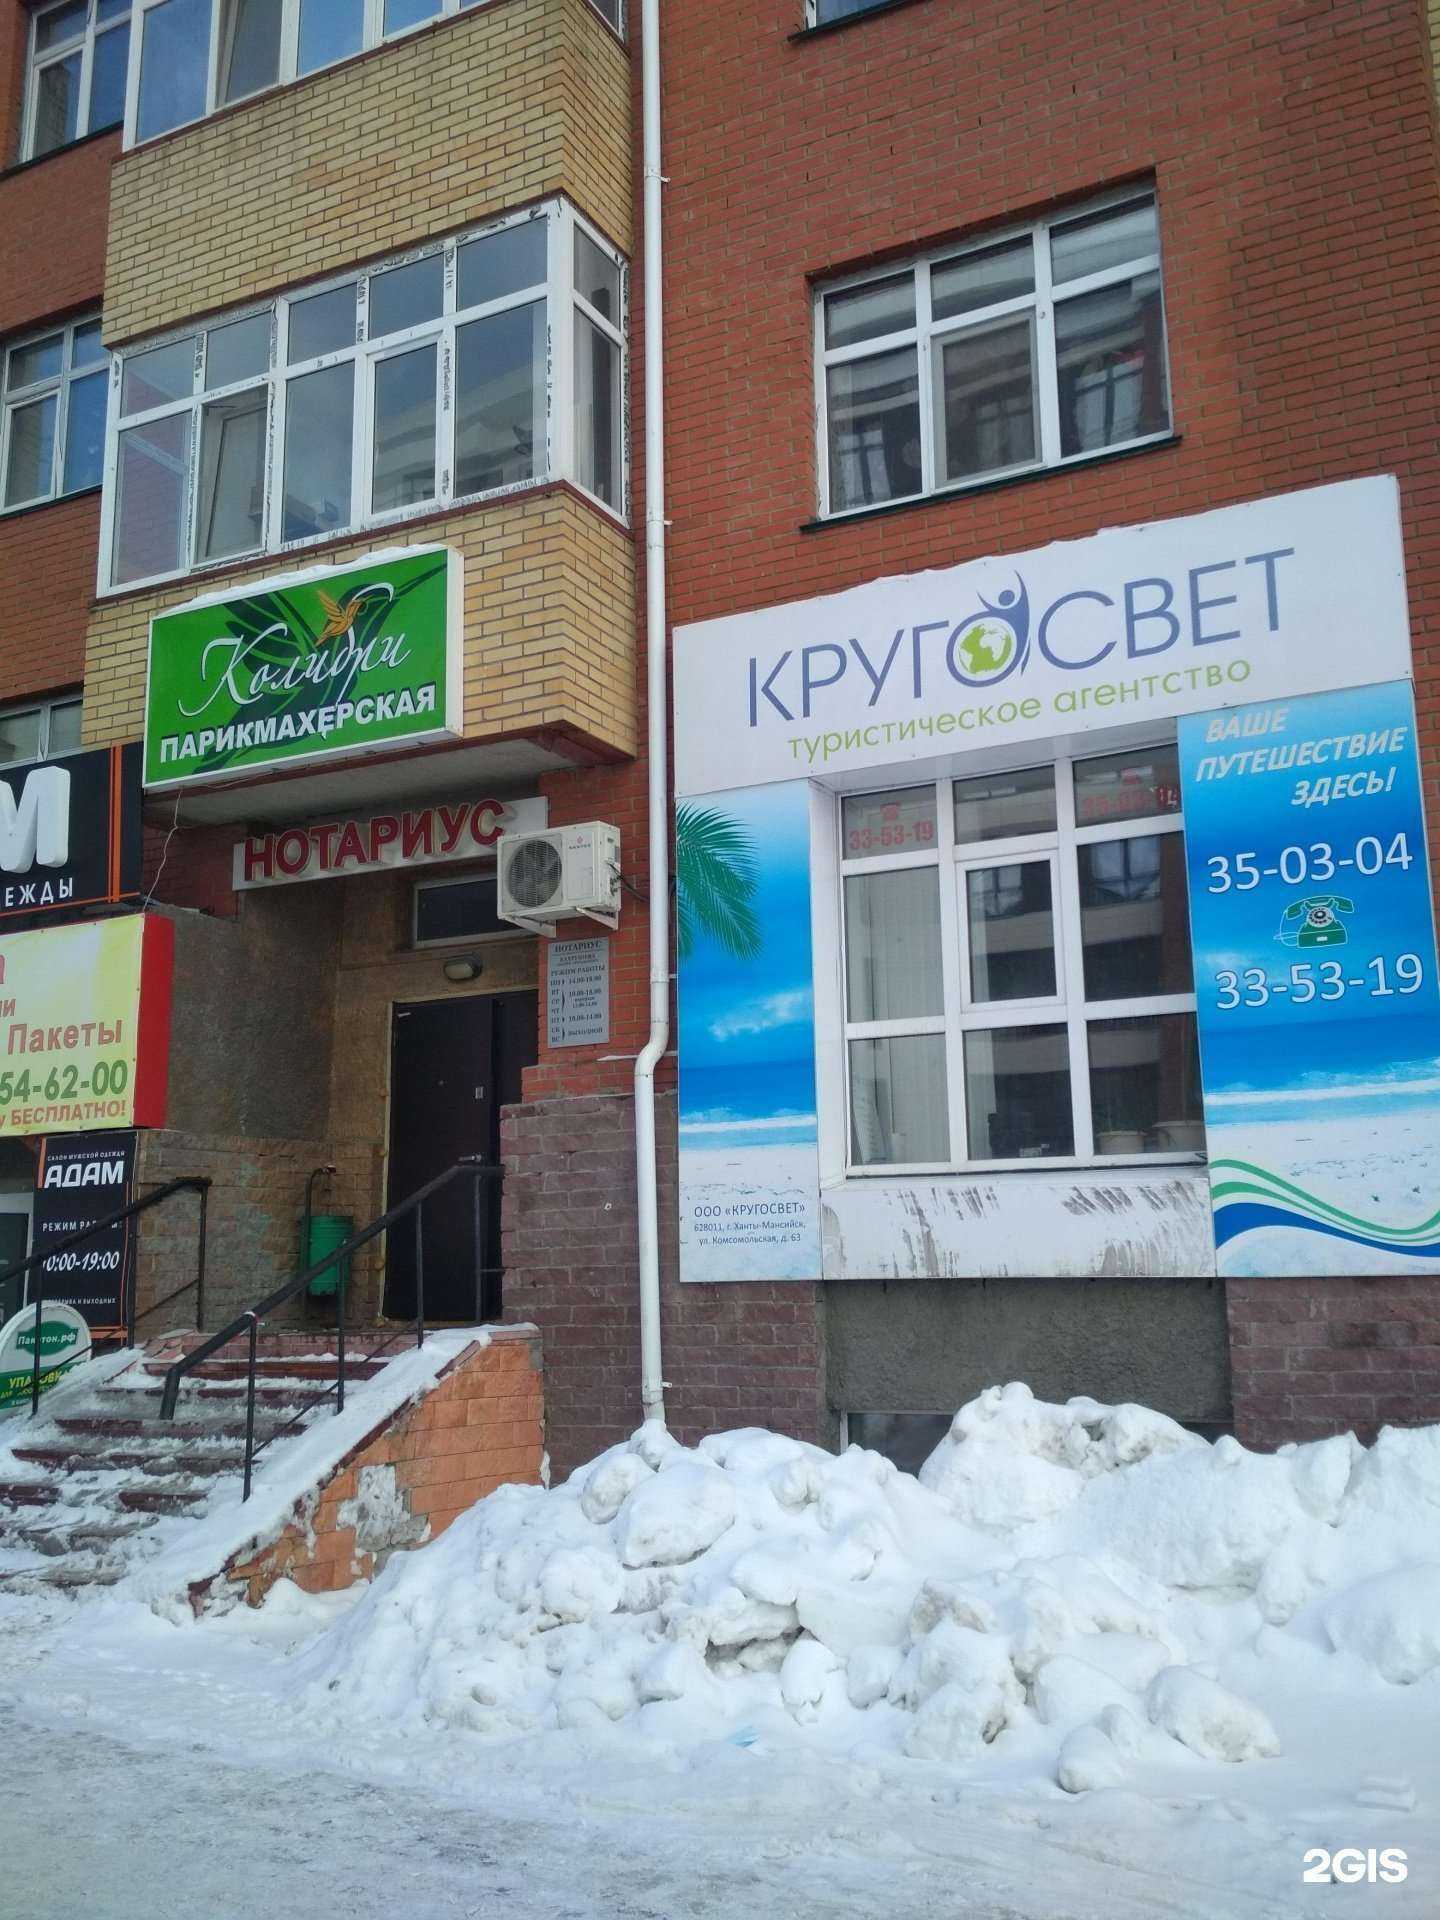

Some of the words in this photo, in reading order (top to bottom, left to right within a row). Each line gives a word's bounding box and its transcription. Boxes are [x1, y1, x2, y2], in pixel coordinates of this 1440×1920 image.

[178, 582, 412, 717] Колибри
[750, 547, 1294, 727] КРУГОСВЕТ
[160, 683, 436, 763] ПАРИКМАХЕРСКАЯ
[787, 697, 1041, 763] туристическое
[1054, 660, 1250, 713] агентство
[1205, 706, 1291, 743] ВАШЕ
[1195, 726, 1408, 782] ПУТЕШЕСТВИЕ
[1290, 766, 1397, 809] ЗДЕСЬ!
[244, 800, 504, 881] НОТАРИУС
[1207, 832, 1413, 893] 35-03-04
[1215, 953, 1424, 1009] 33-53-19
[8, 1020, 122, 1055] Пакеты
[11, 1101, 126, 1126] БЕСПЛАТНО!
[44, 1161, 124, 1188] АДАМ
[42, 1222, 76, 1231] РЕЖИМ
[694, 1205, 721, 1217] ООО
[725, 1202, 805, 1216] «КРУГОСВЕТ»
[18, 1332, 76, 1345] Пактон.рф
